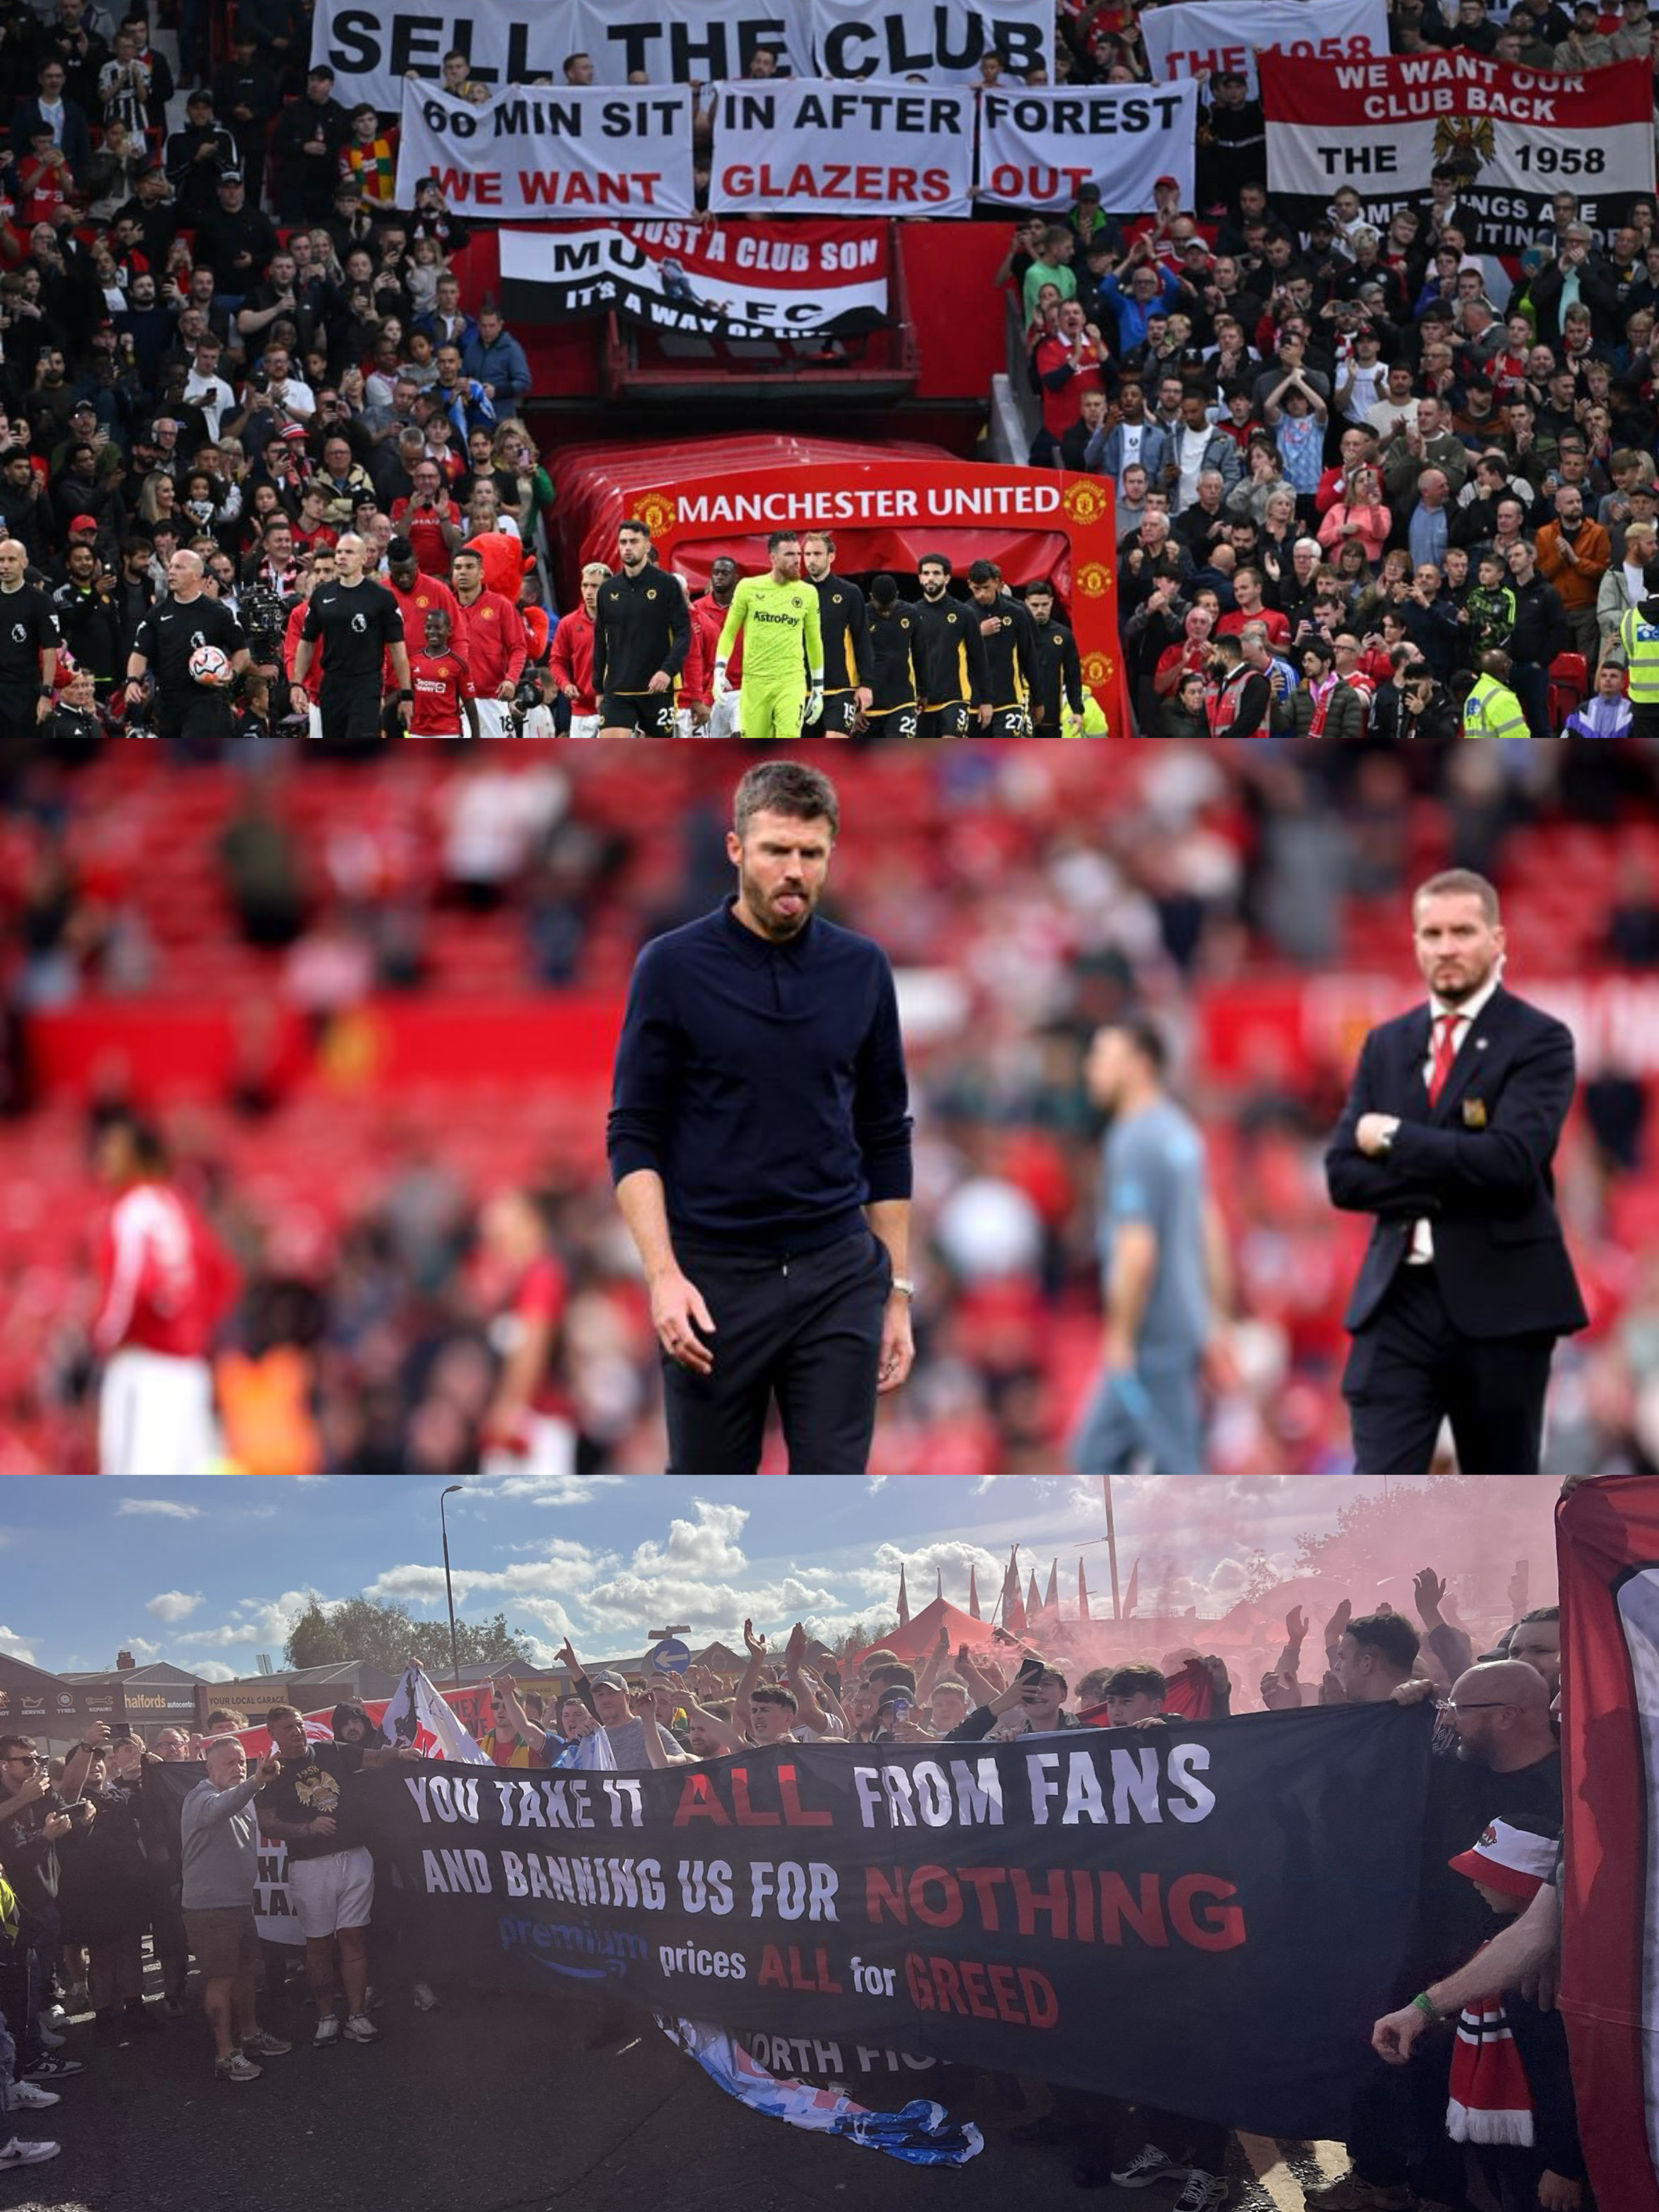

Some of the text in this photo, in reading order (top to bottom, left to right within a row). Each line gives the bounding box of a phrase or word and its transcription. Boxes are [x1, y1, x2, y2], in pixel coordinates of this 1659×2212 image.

[329, 5, 1045, 84] SELL THE CLUB
[1166, 47, 1246, 80] THE
[1335, 57, 1585, 93] WE WANT OUR
[423, 99, 683, 138] 60 MIN SIT
[725, 95, 961, 134] IN AFTER
[987, 96, 1182, 134] FOREST
[1364, 88, 1556, 122] CLUB BACK
[1318, 145, 1606, 174] THE 1958
[430, 166, 662, 205] WE WANT
[722, 164, 950, 202] GLAZERS
[992, 163, 1092, 200] OUT
[1538, 203, 1597, 222] AE
[631, 221, 878, 272] JUST A CLUB SON
[554, 239, 824, 323] MU FC
[566, 275, 616, 309] IT'S
[625, 294, 641, 314] A
[651, 301, 716, 333] WAY
[774, 328, 832, 339] LI
[678, 486, 1060, 523] MANCHESTER UNITED
[754, 610, 800, 628] AstroPay
[500, 715, 513, 732] 18
[899, 715, 916, 734] 22
[1005, 713, 1022, 730] 27
[124, 1694, 166, 1708] halfords
[257, 1696, 285, 1704] GARAGE
[296, 1765, 319, 1779] 1958
[404, 1743, 1216, 1829] YOU TAKE IT ALL FROM FANS
[422, 1848, 1246, 1953] AND BANNING US FOR NOTHING
[500, 1913, 1059, 2029] premium prices ALL for GREED
[747, 2033, 844, 2073] ORTH
